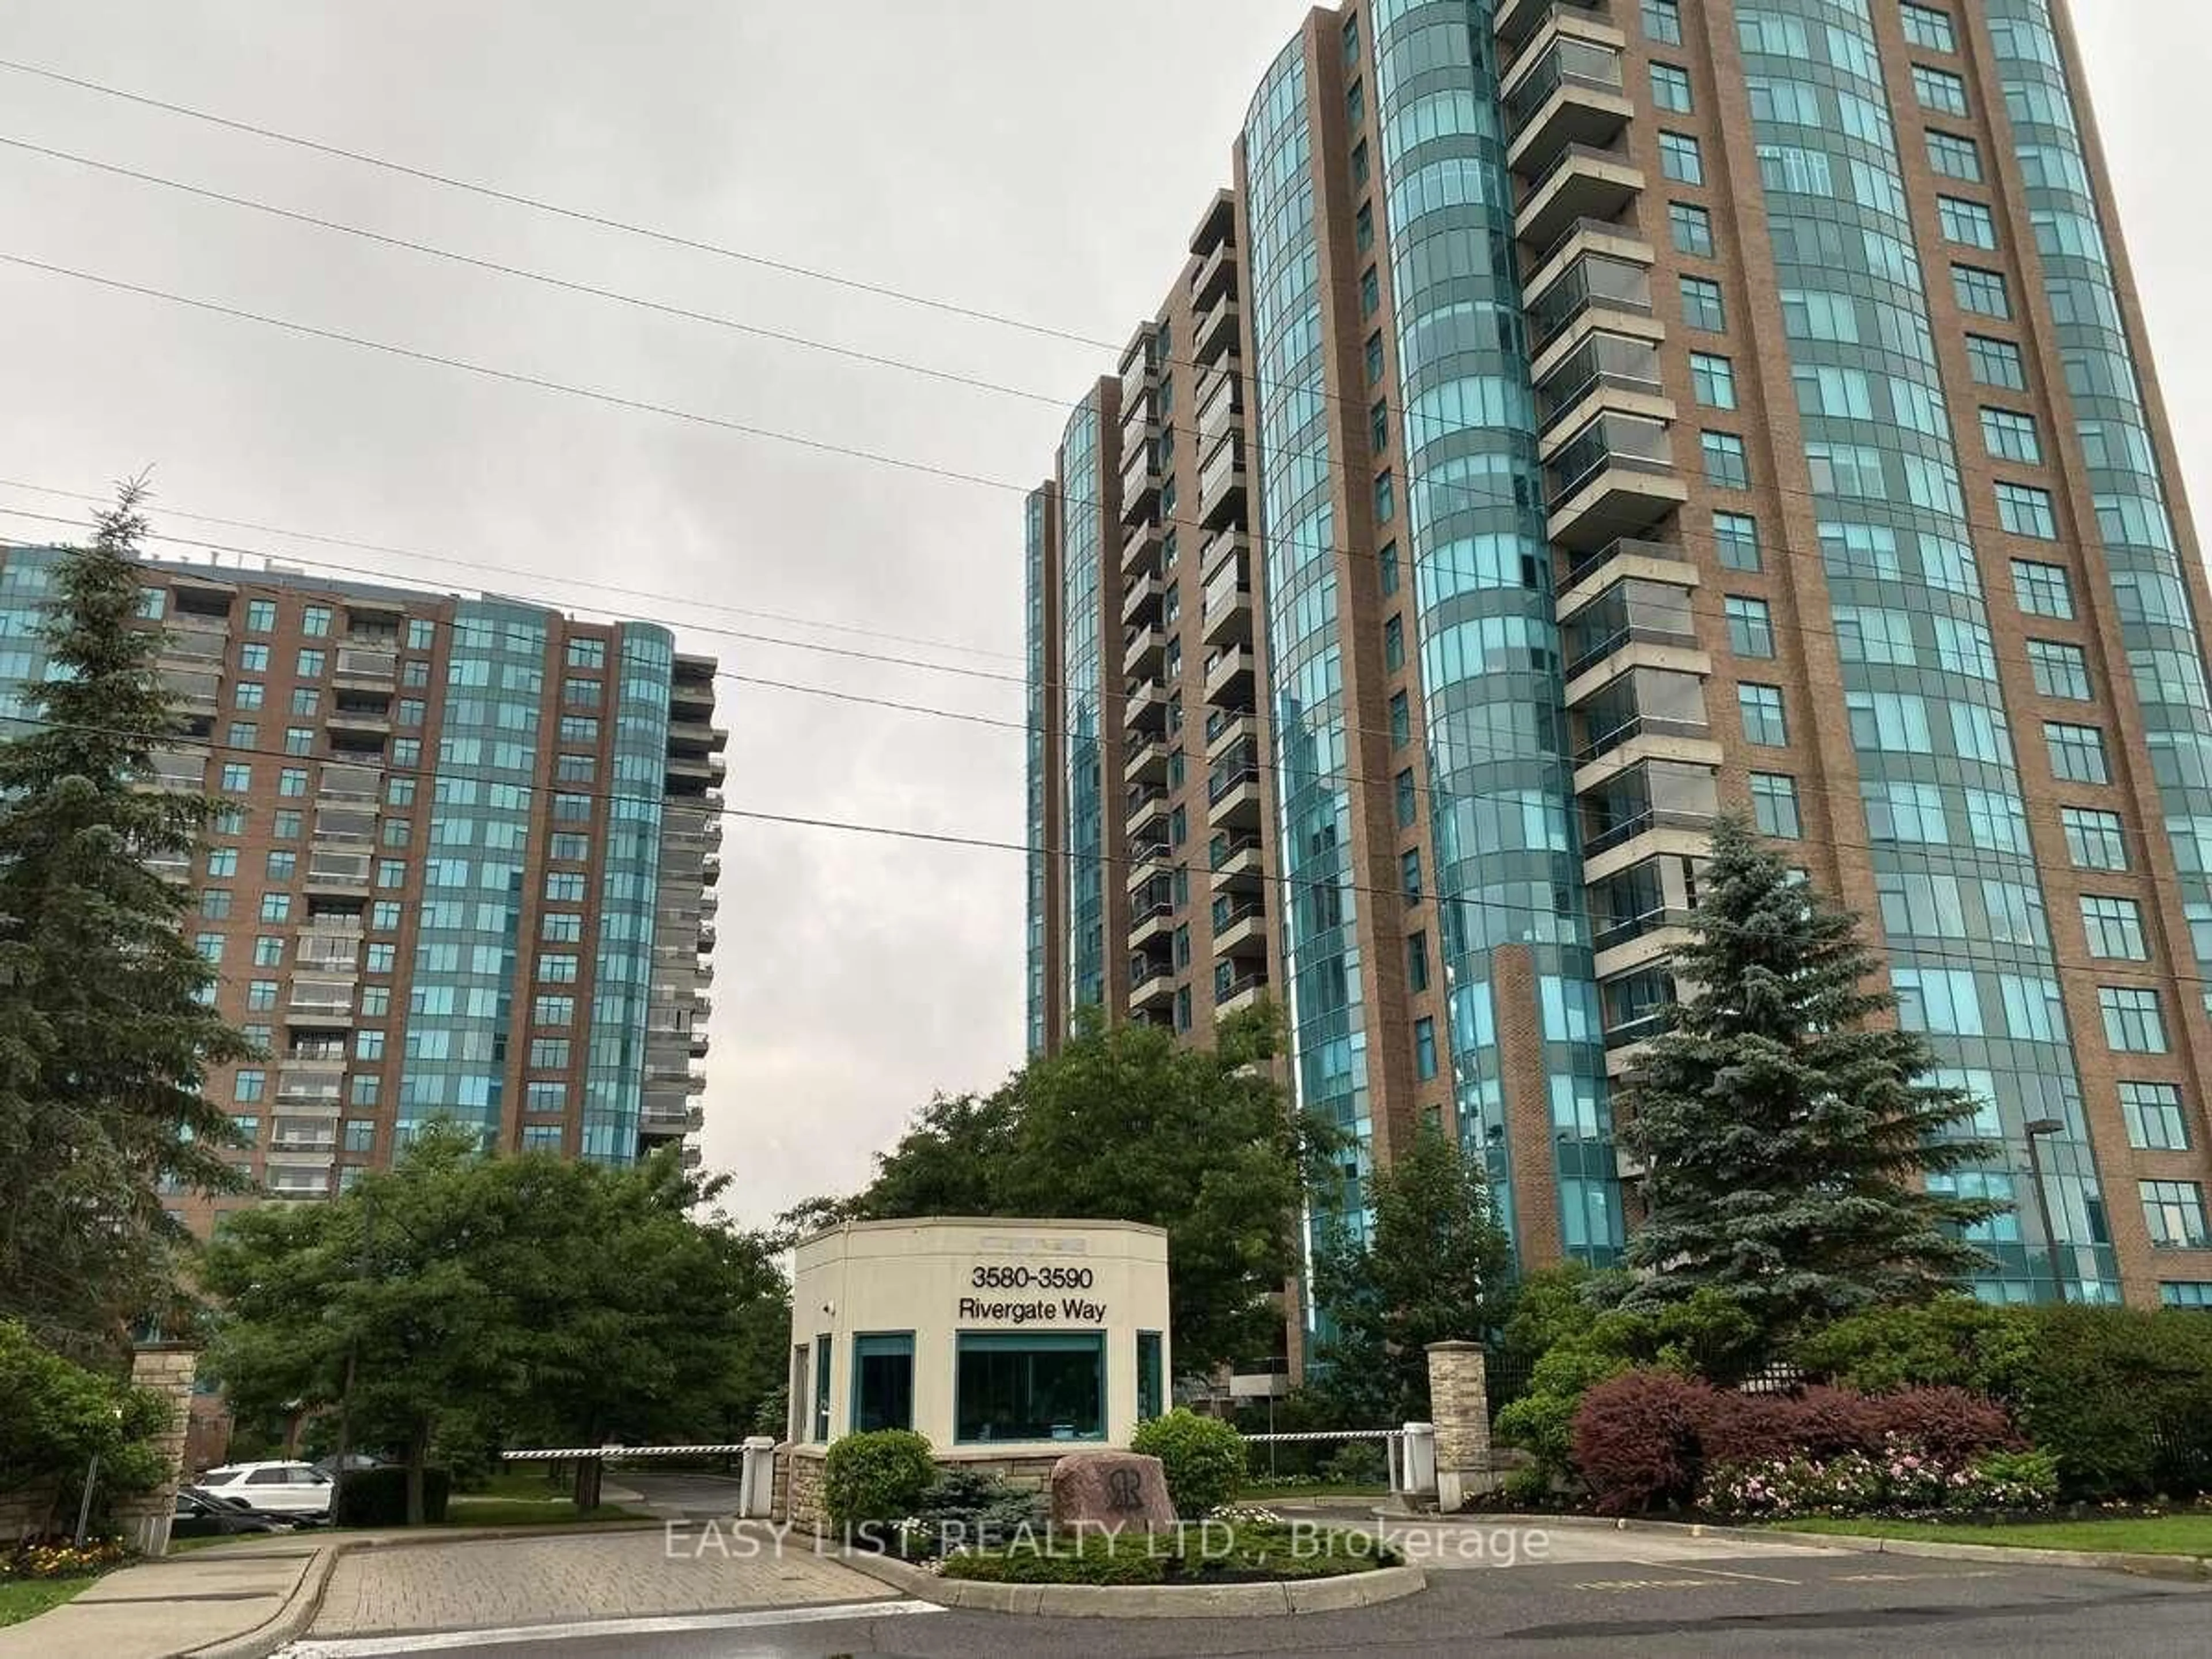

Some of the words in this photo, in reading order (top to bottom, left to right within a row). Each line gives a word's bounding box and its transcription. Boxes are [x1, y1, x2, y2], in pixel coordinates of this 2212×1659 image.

[972, 1267, 1093, 1288] 3580-3590
[959, 1298, 1056, 1323] Rivergate
[1063, 1299, 1107, 1323] Way
